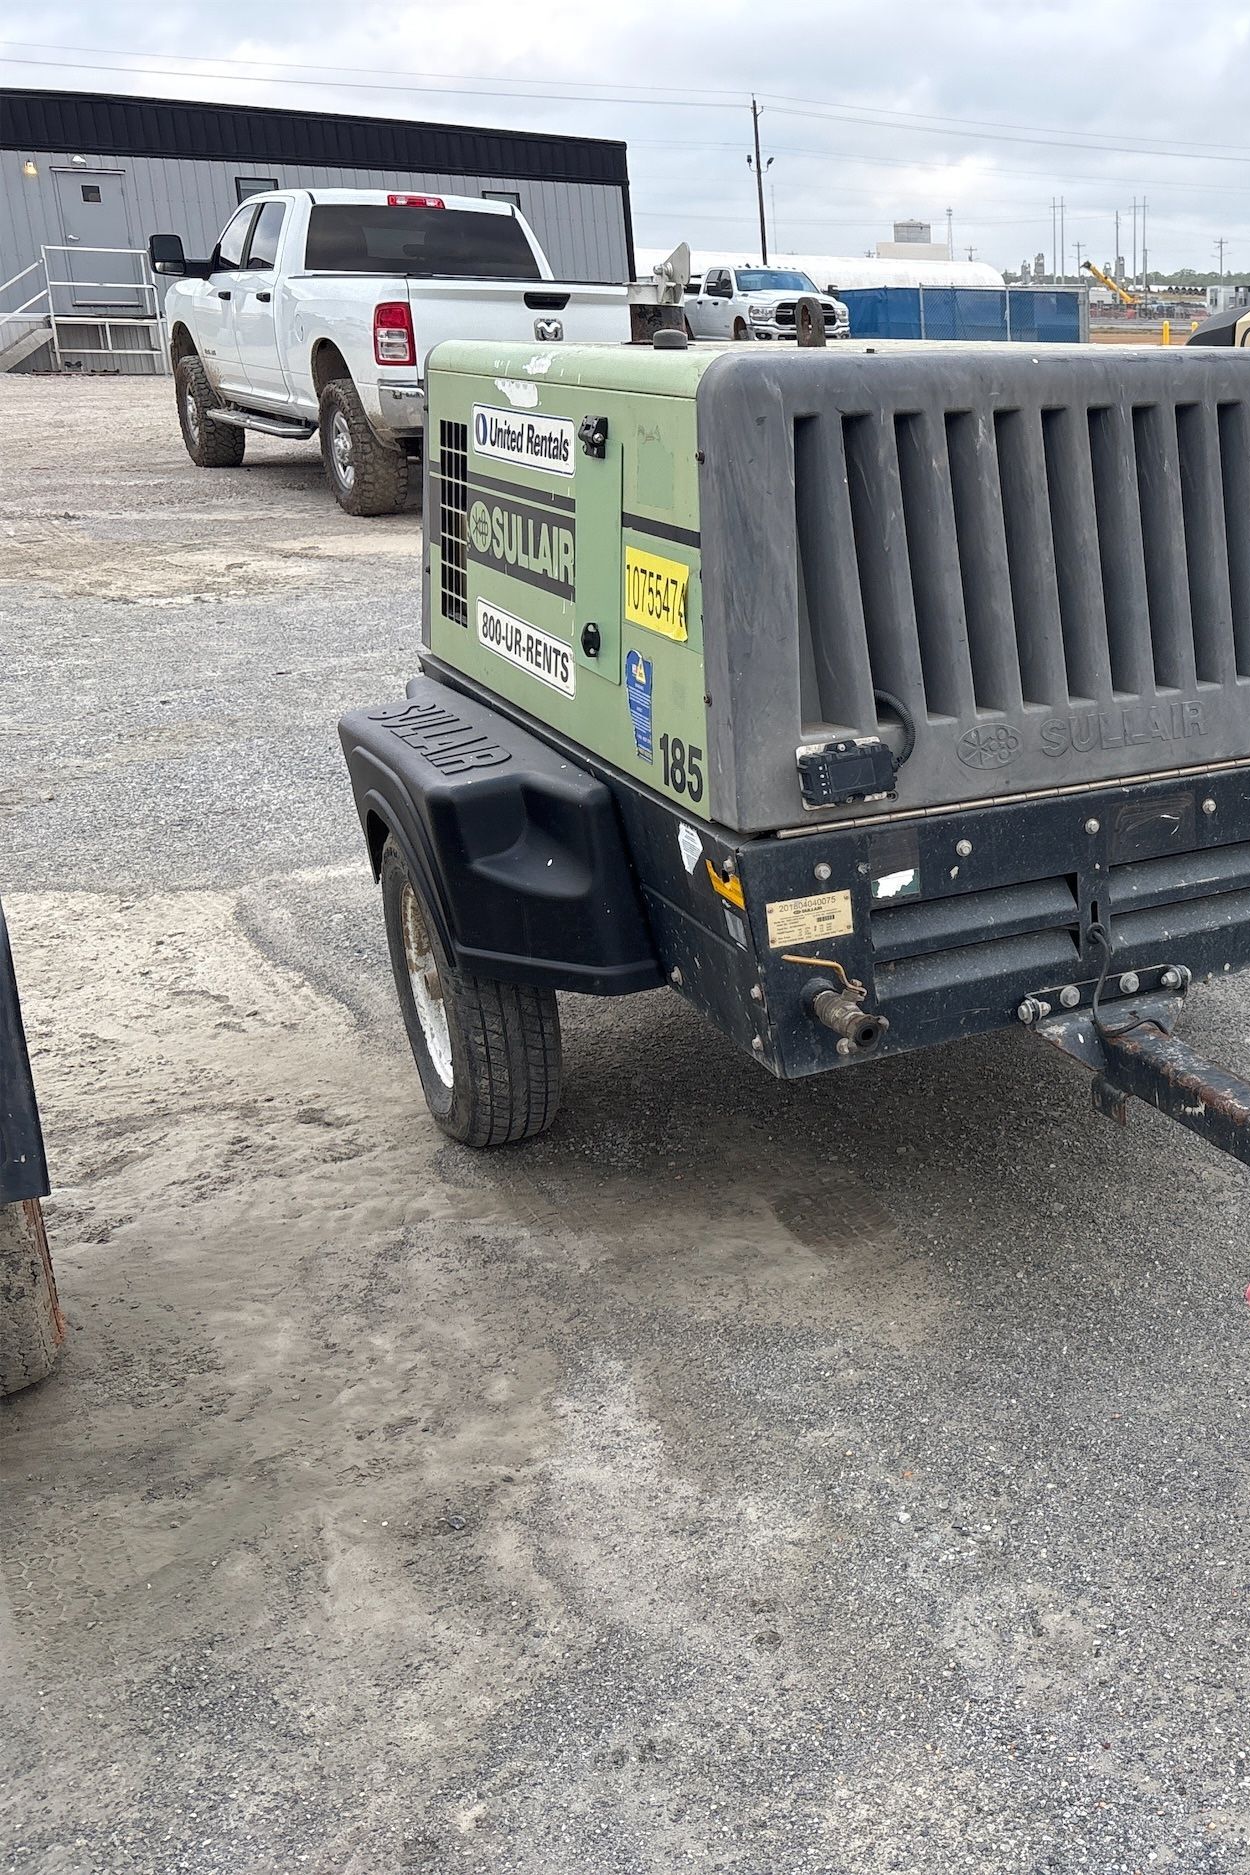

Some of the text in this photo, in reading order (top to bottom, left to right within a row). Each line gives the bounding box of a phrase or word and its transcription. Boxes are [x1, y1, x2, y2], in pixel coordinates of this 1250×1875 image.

[489, 417, 569, 462] United Rentals
[492, 506, 575, 586] SULLAIR
[482, 611, 569, 683] 800-UR-RENTS
[368, 703, 512, 775] SULLAIR
[1040, 700, 1208, 757] SULLAIR
[659, 733, 704, 803] 185
